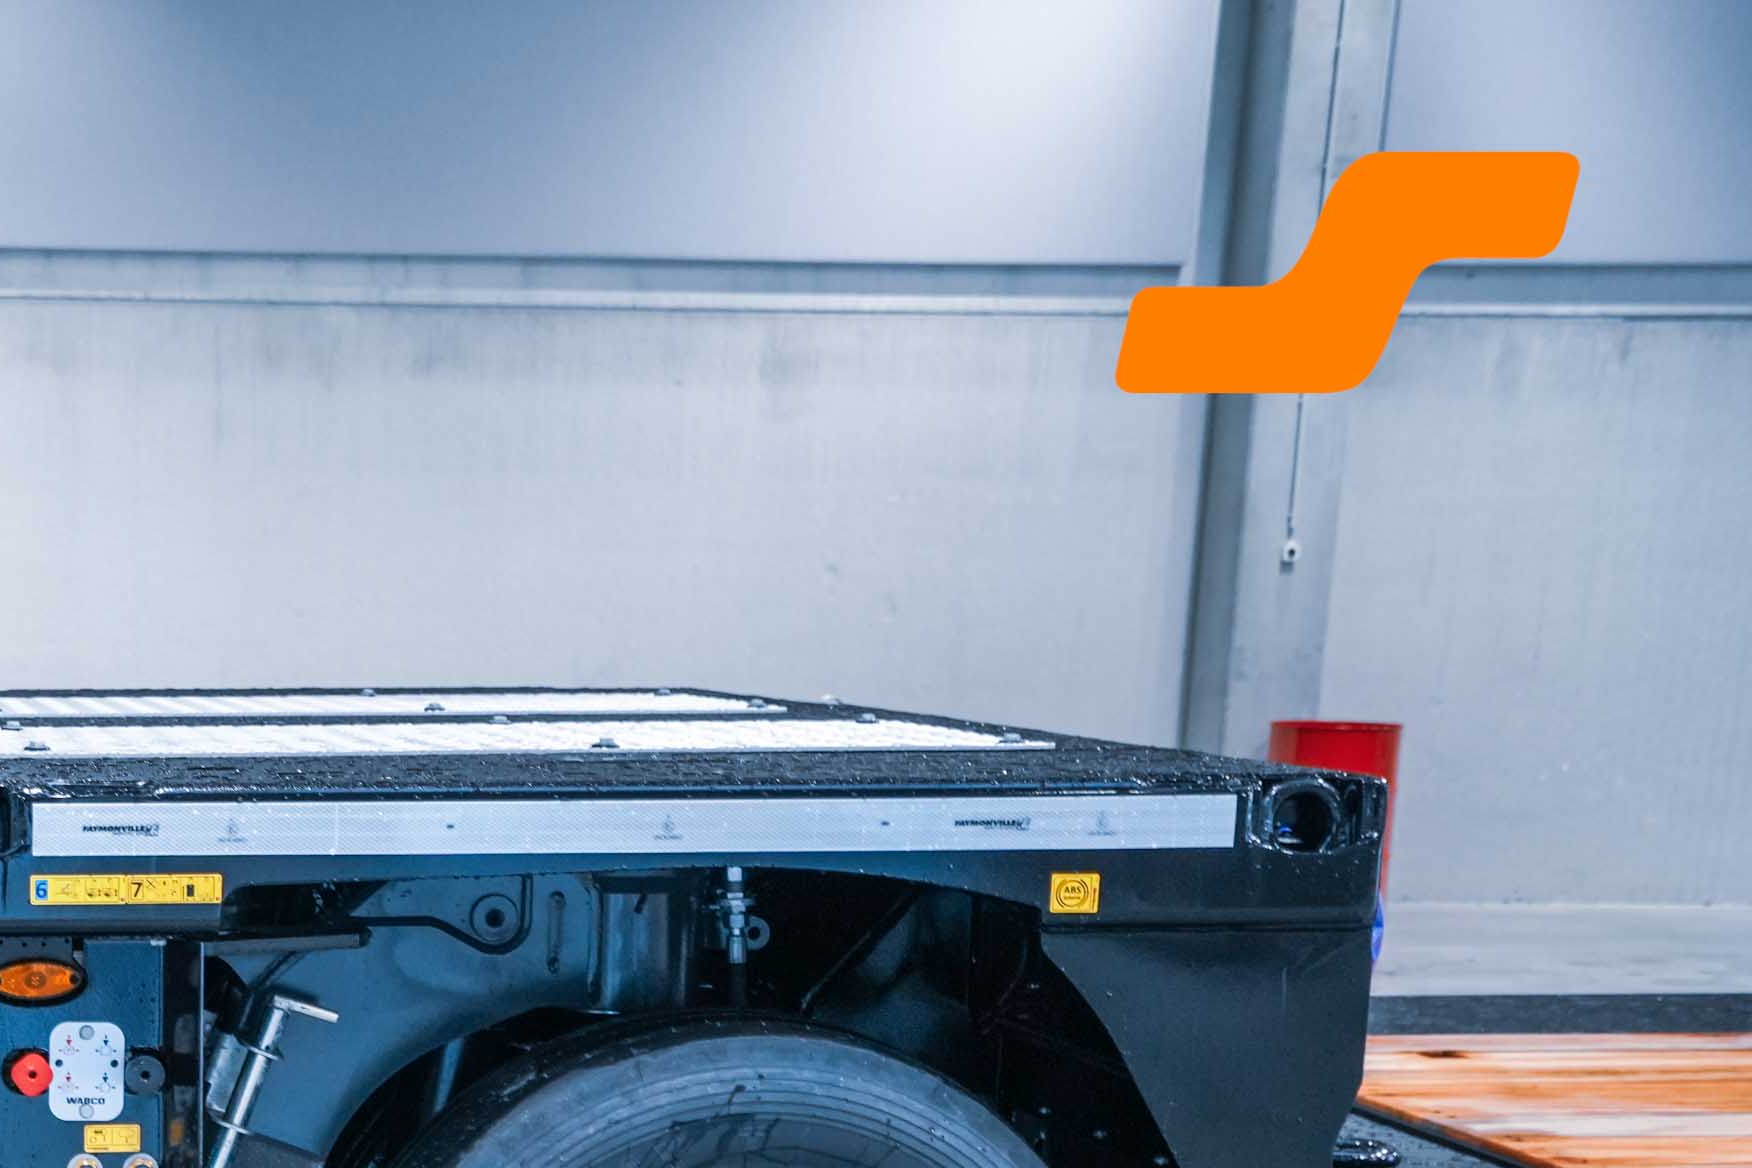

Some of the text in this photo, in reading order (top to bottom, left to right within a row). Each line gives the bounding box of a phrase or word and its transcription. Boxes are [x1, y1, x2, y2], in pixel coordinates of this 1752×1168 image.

[35, 881, 48, 899] 6
[130, 882, 143, 898] 7
[1064, 886, 1081, 894] ABS
[66, 1097, 105, 1105] WABCO
